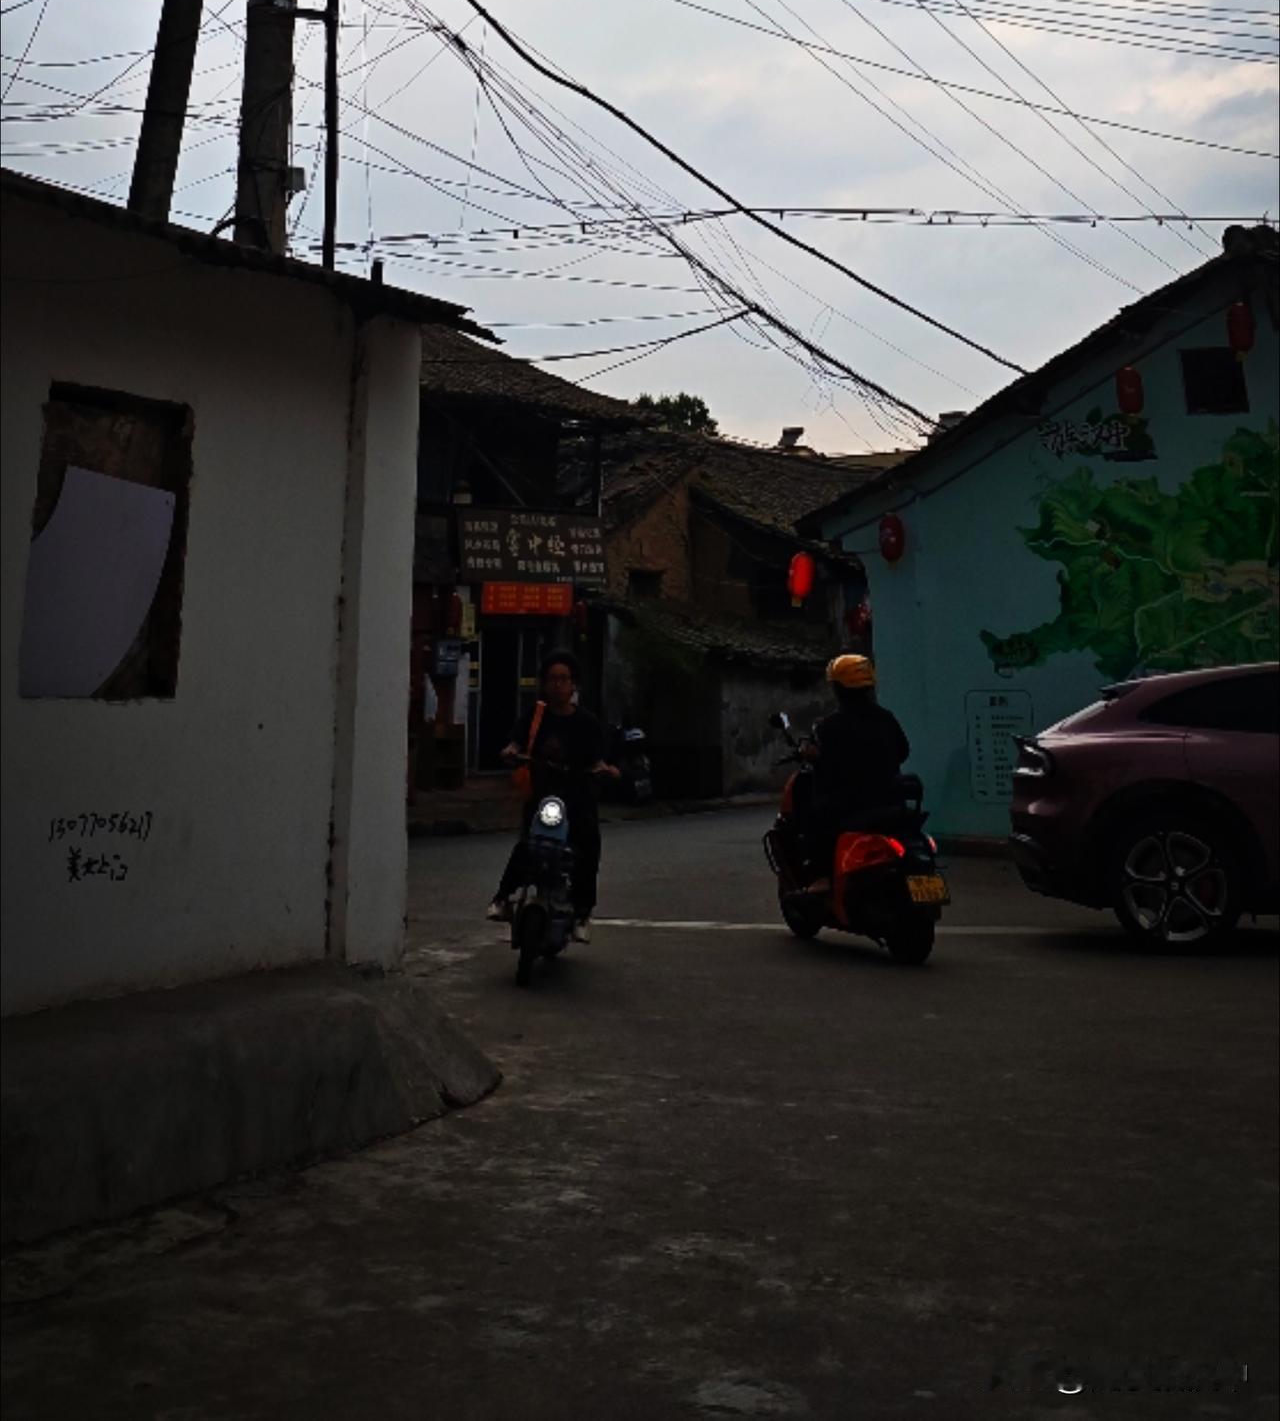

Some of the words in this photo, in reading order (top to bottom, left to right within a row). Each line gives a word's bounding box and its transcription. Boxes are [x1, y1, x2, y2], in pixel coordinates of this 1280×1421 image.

[48, 811, 153, 842] 13077056217
[67, 846, 128, 883] 美女上门
